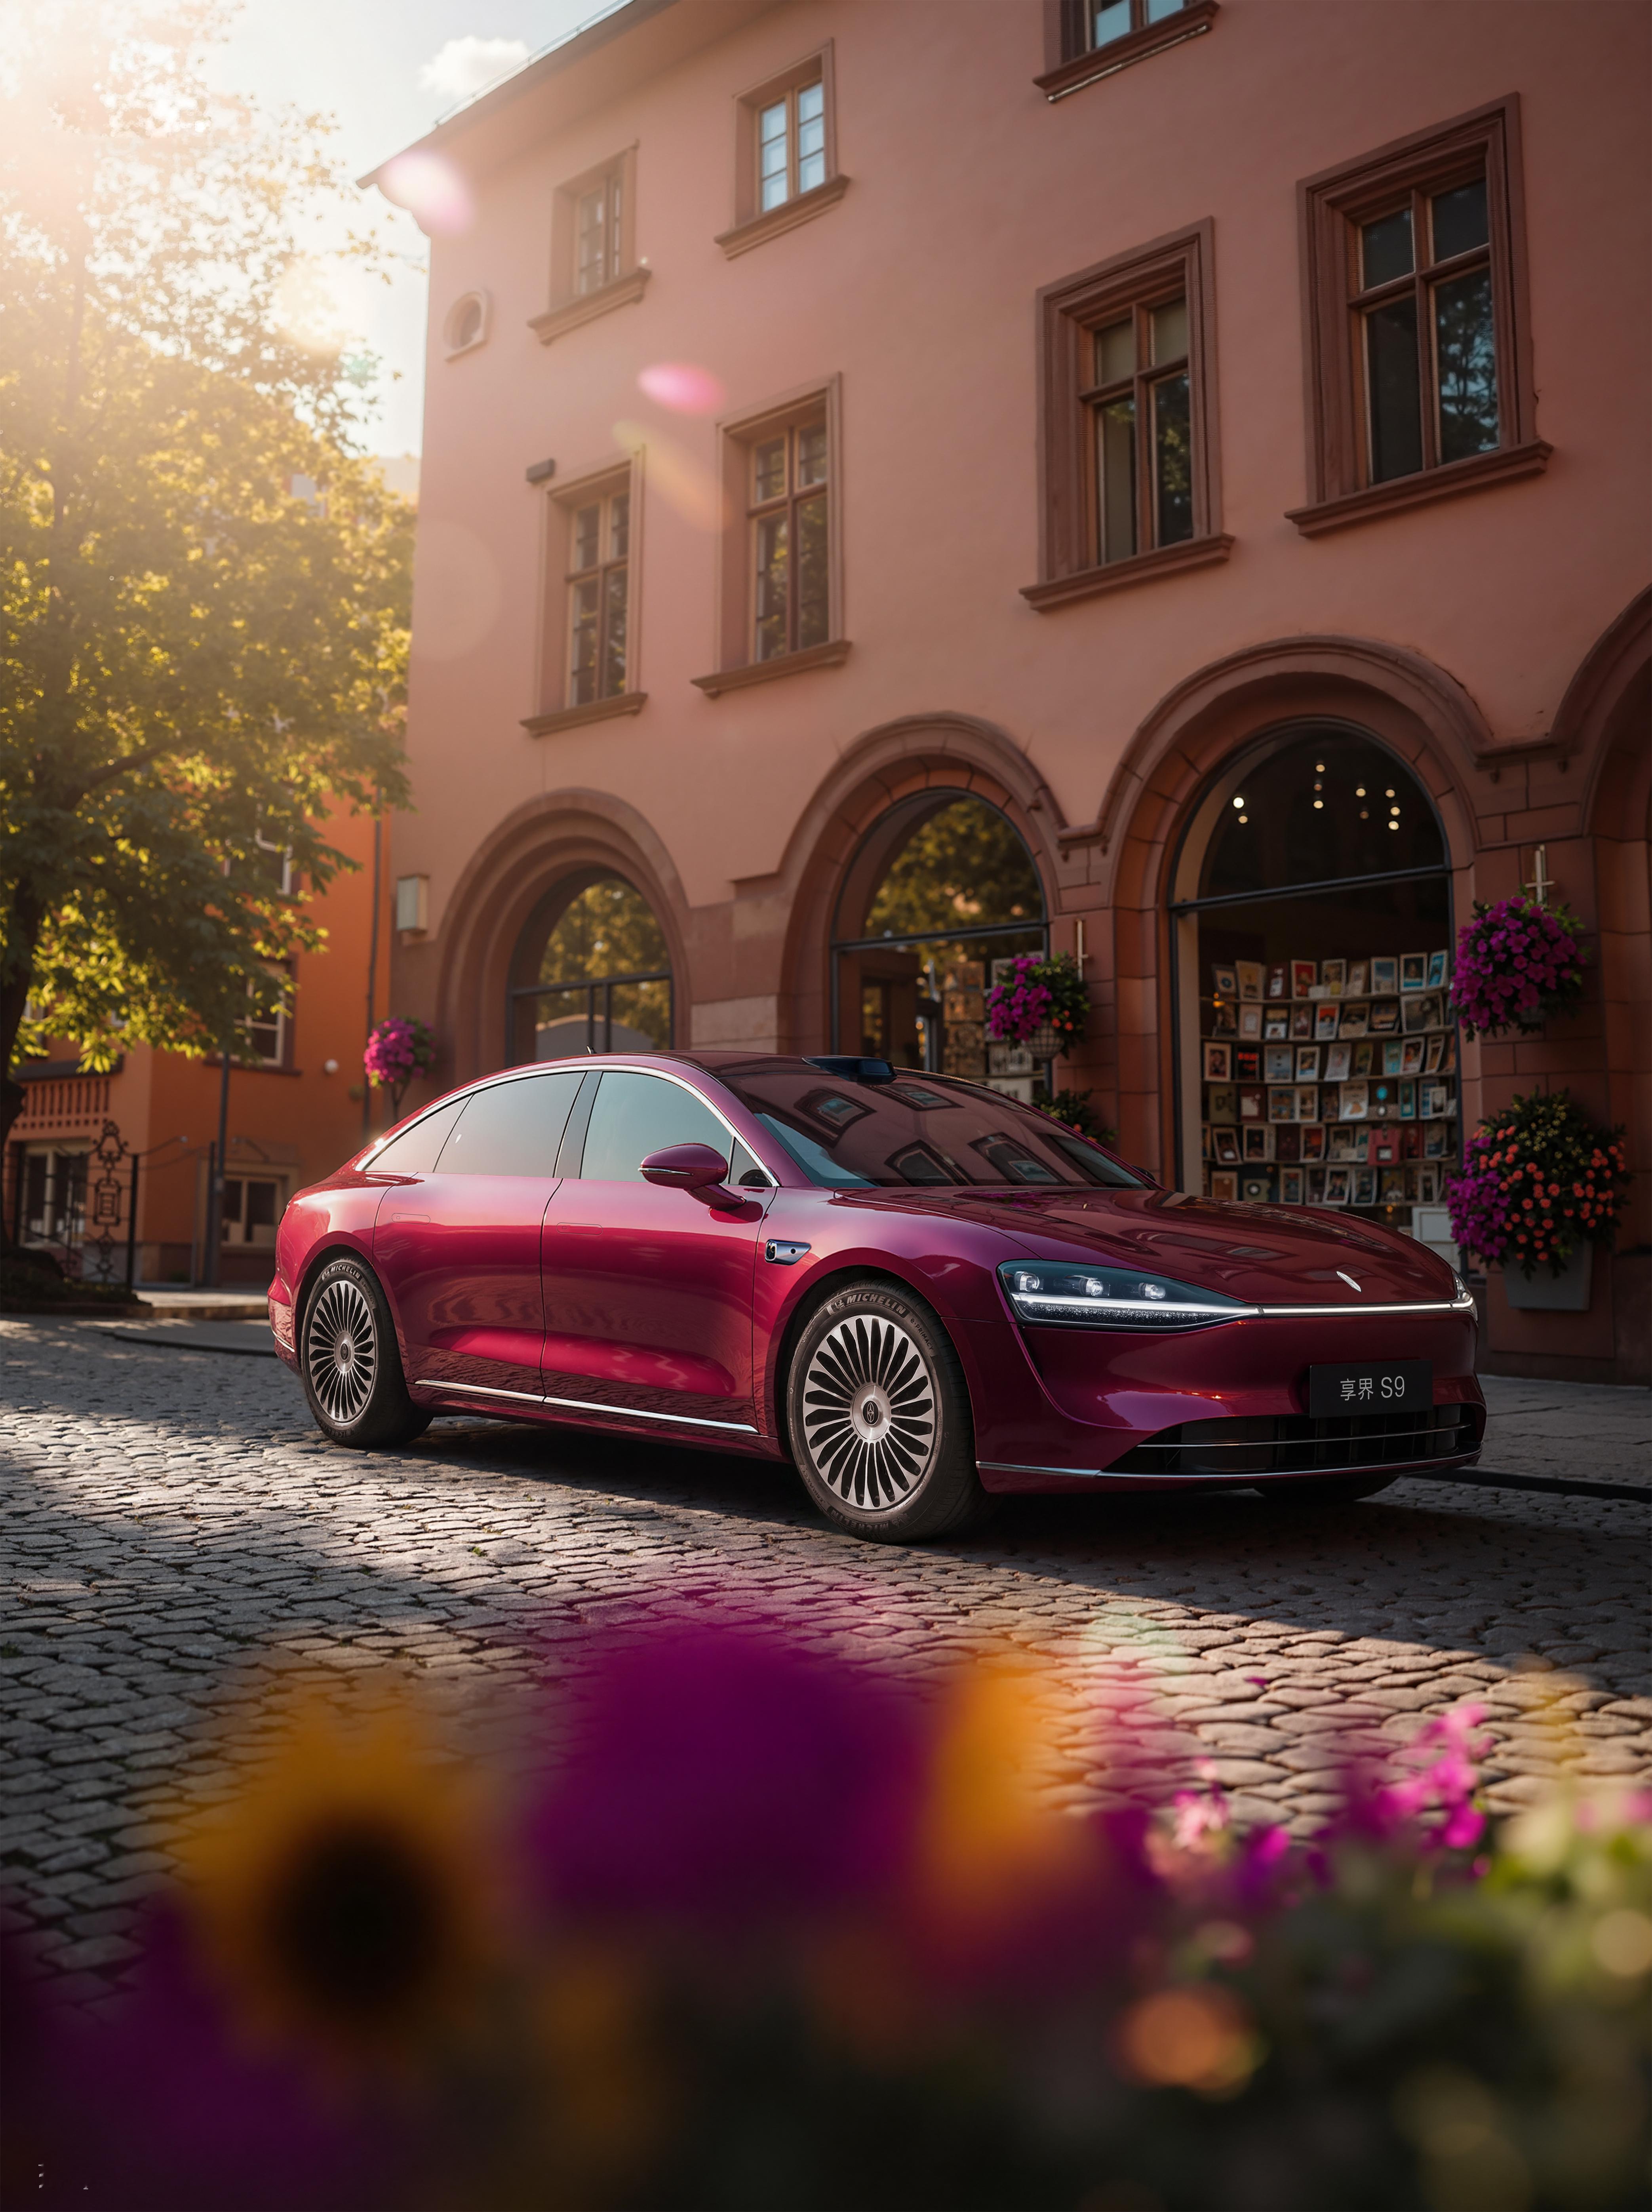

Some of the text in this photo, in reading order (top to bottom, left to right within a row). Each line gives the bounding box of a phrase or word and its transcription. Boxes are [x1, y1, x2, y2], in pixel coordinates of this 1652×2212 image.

[331, 1265, 361, 1279] MICHELIN
[847, 1293, 906, 1315] MICHELIN
[1340, 1376, 1405, 1401] 享界 S9
[831, 1509, 889, 1530] MICHELIN
